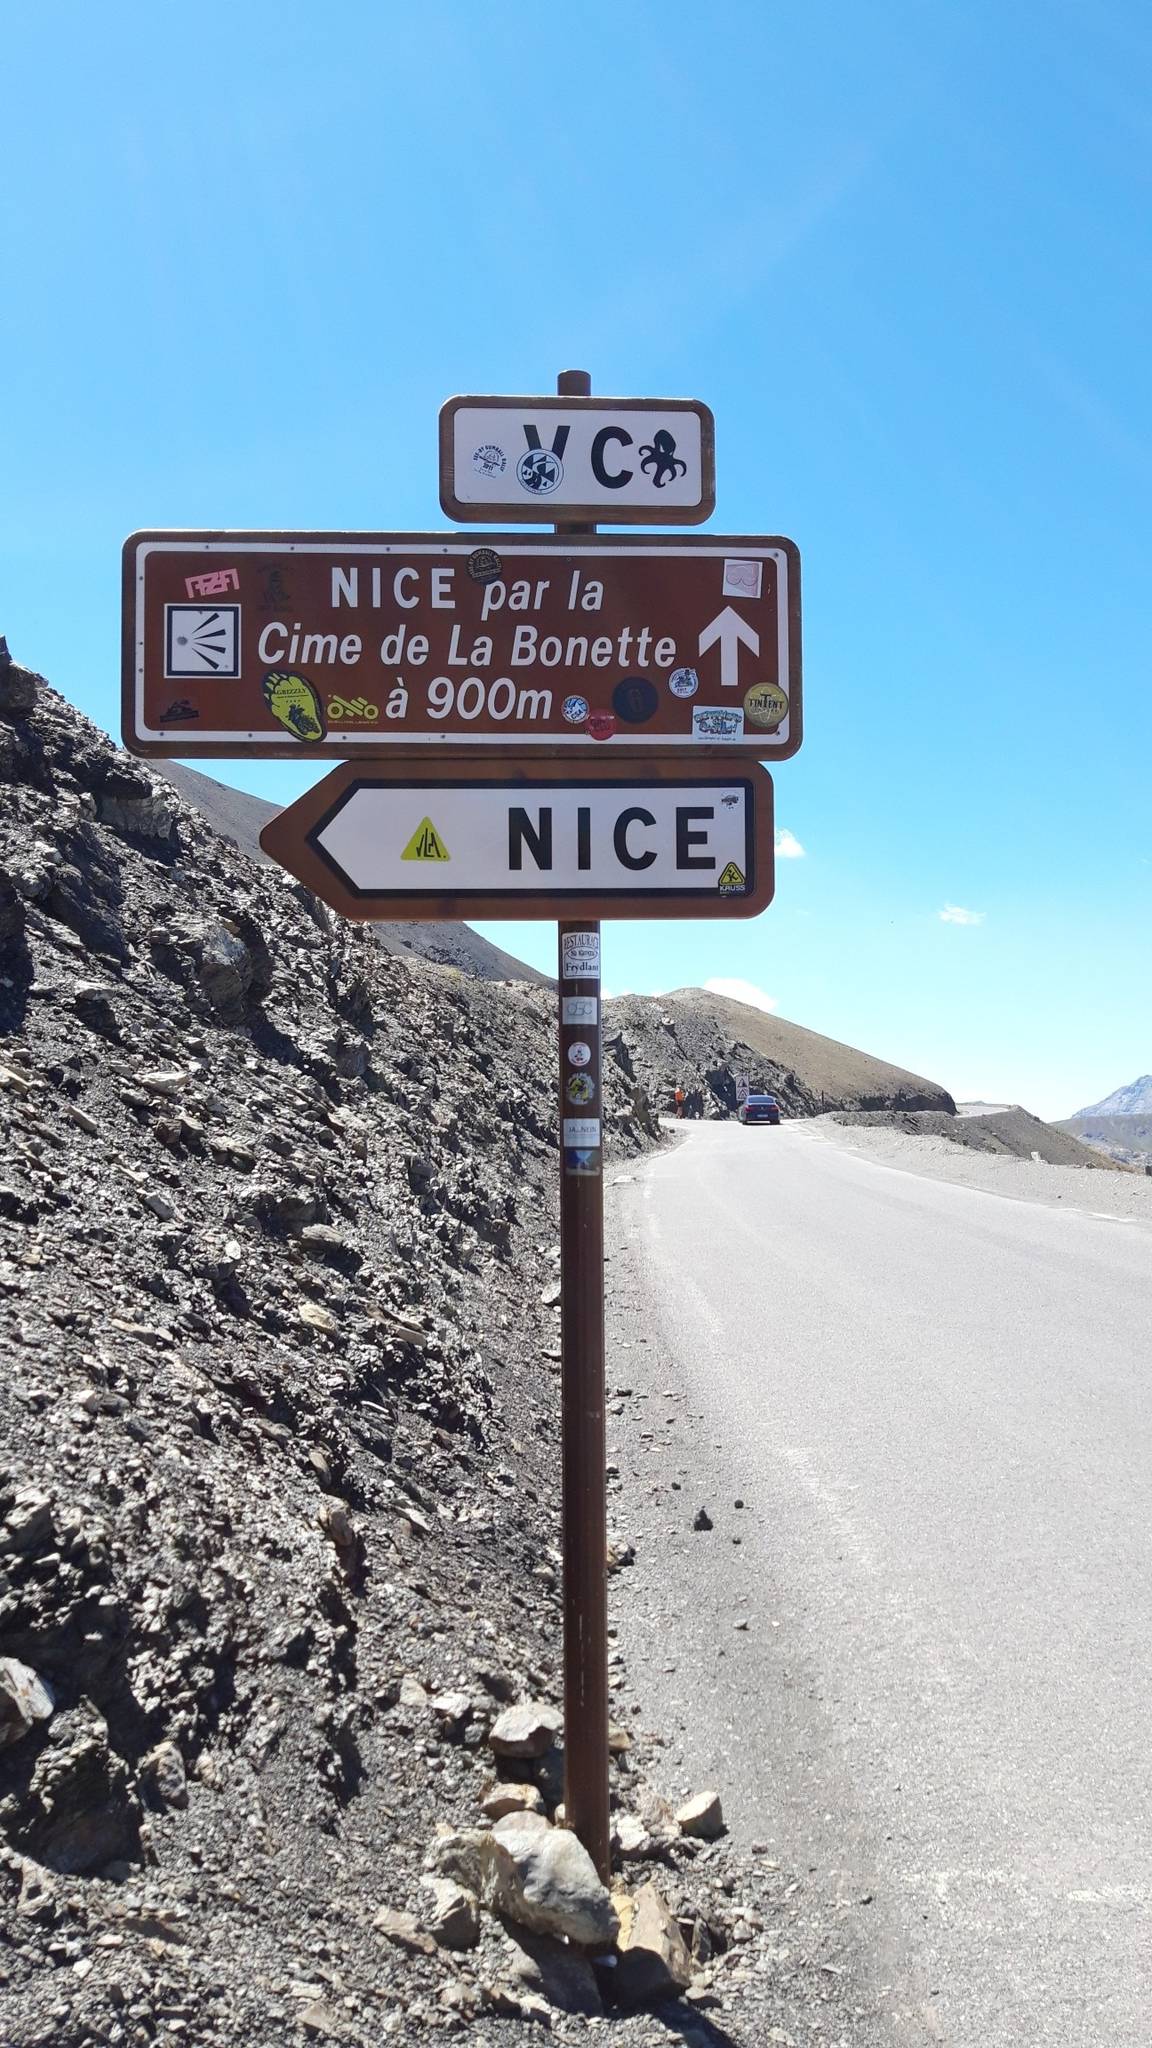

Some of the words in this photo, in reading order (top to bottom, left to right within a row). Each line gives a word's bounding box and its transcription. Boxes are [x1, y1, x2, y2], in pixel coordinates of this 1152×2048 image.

[331, 567, 456, 608] NICE
[480, 579, 550, 621] par
[568, 570, 604, 611] la
[258, 621, 363, 665] Cime
[380, 624, 430, 665] de
[447, 624, 493, 666] La
[510, 625, 677, 667] Bonette
[385, 677, 409, 718] à
[426, 676, 553, 720] 900m
[508, 807, 716, 870] NICE
